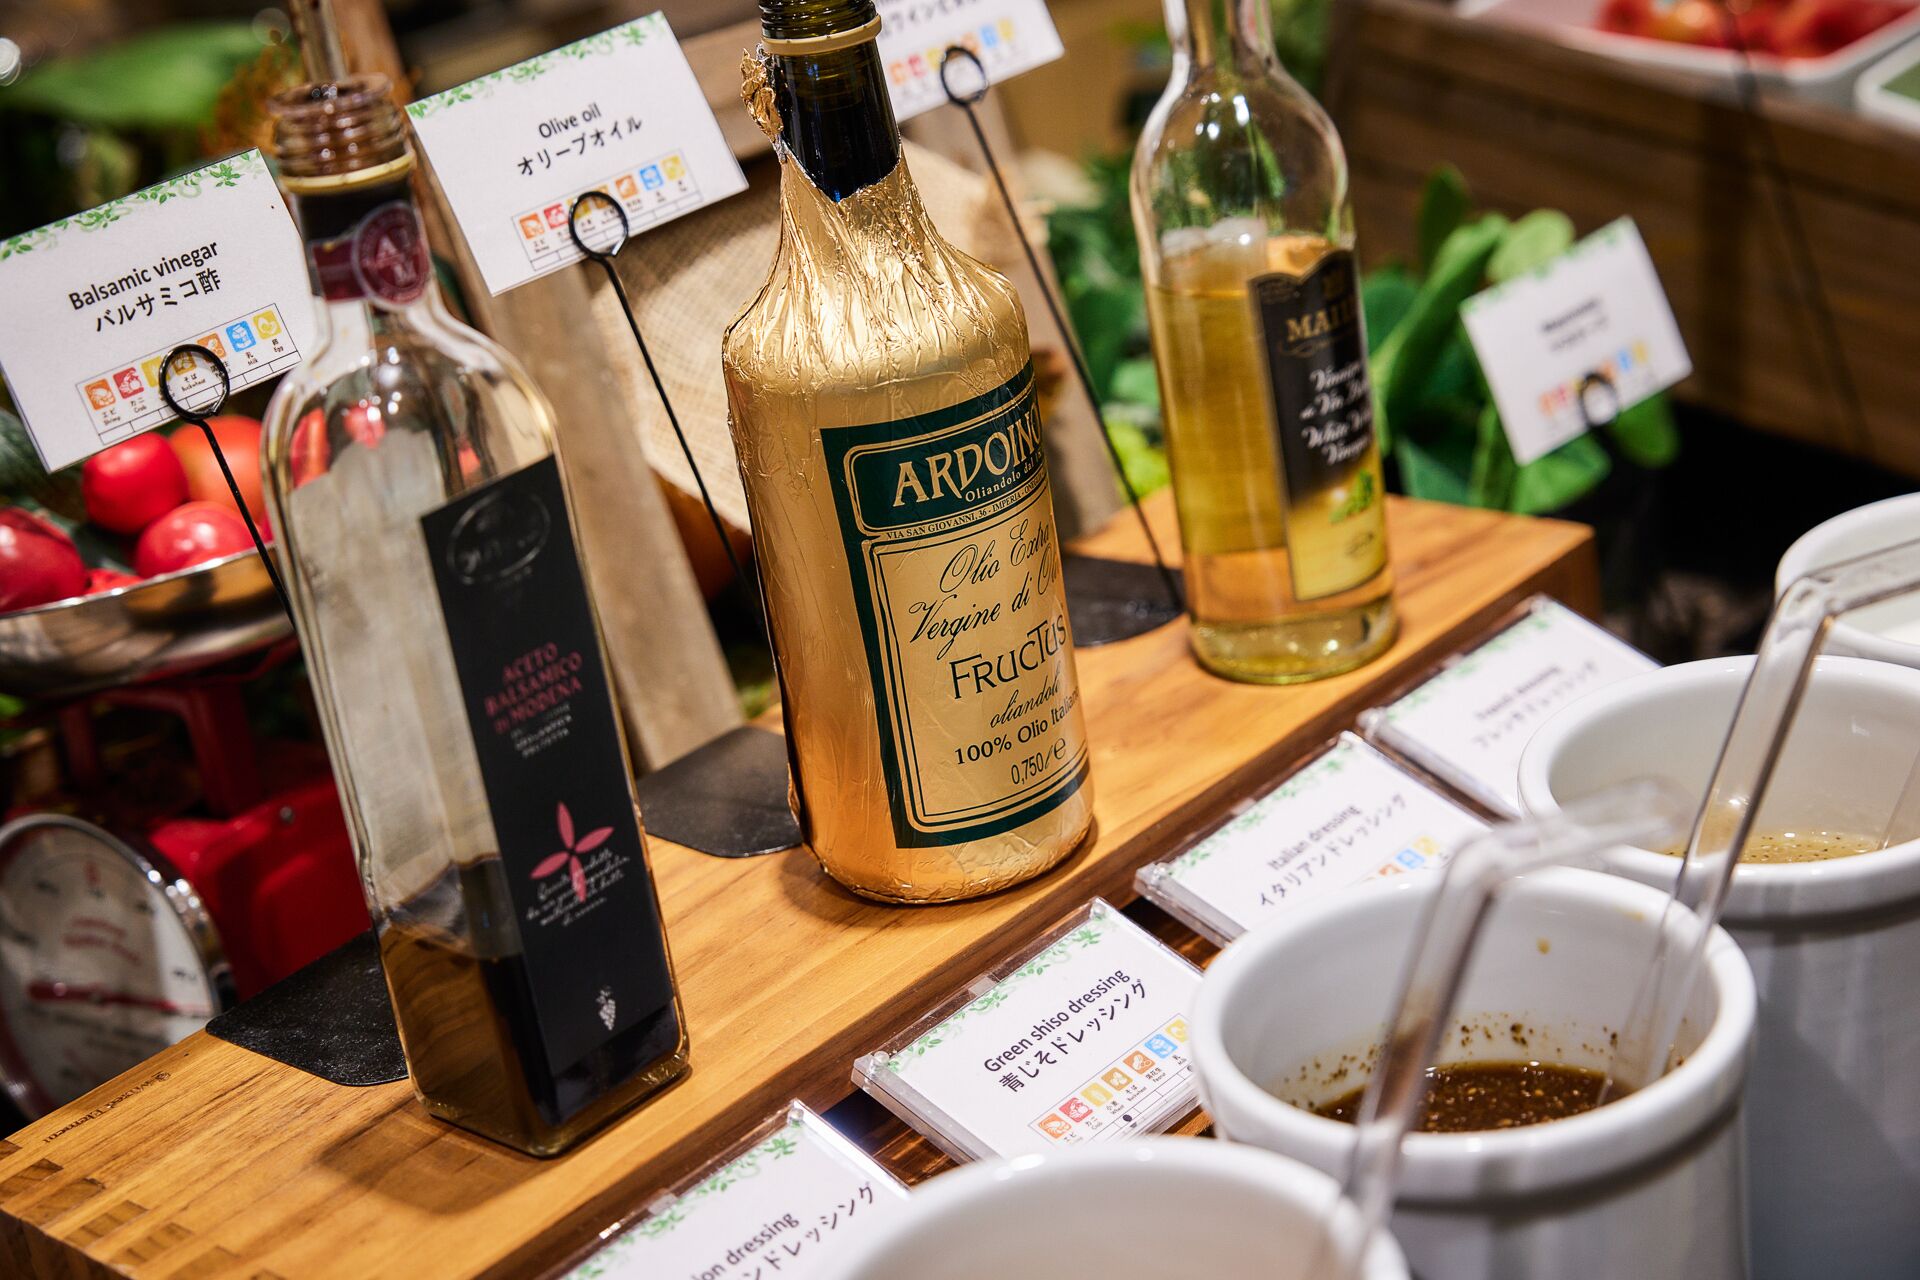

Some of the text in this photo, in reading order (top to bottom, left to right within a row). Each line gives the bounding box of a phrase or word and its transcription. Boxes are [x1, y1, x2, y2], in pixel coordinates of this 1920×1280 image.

[517, 116, 643, 176] オリーブオイル
[538, 102, 602, 139] Olive oil
[68, 242, 218, 311] Balsamic vinegar
[96, 267, 222, 332] バルサミコ酢
[892, 402, 1042, 508] ARDOINO
[886, 529, 904, 541] VIA
[906, 525, 927, 537] SAN
[979, 508, 988, 519] 36
[992, 492, 1022, 512] IMPERIA
[965, 471, 1021, 503] Oliandolo
[939, 540, 1001, 593] Olio
[908, 594, 1001, 660] Vergine
[1011, 571, 1033, 613] di
[954, 734, 1012, 765] 100%
[1017, 718, 1049, 744] Olio
[984, 969, 1131, 1073] Green shiso dressing
[998, 979, 1147, 1093] 青じそドレッシング
[726, 1213, 800, 1266] dressing
